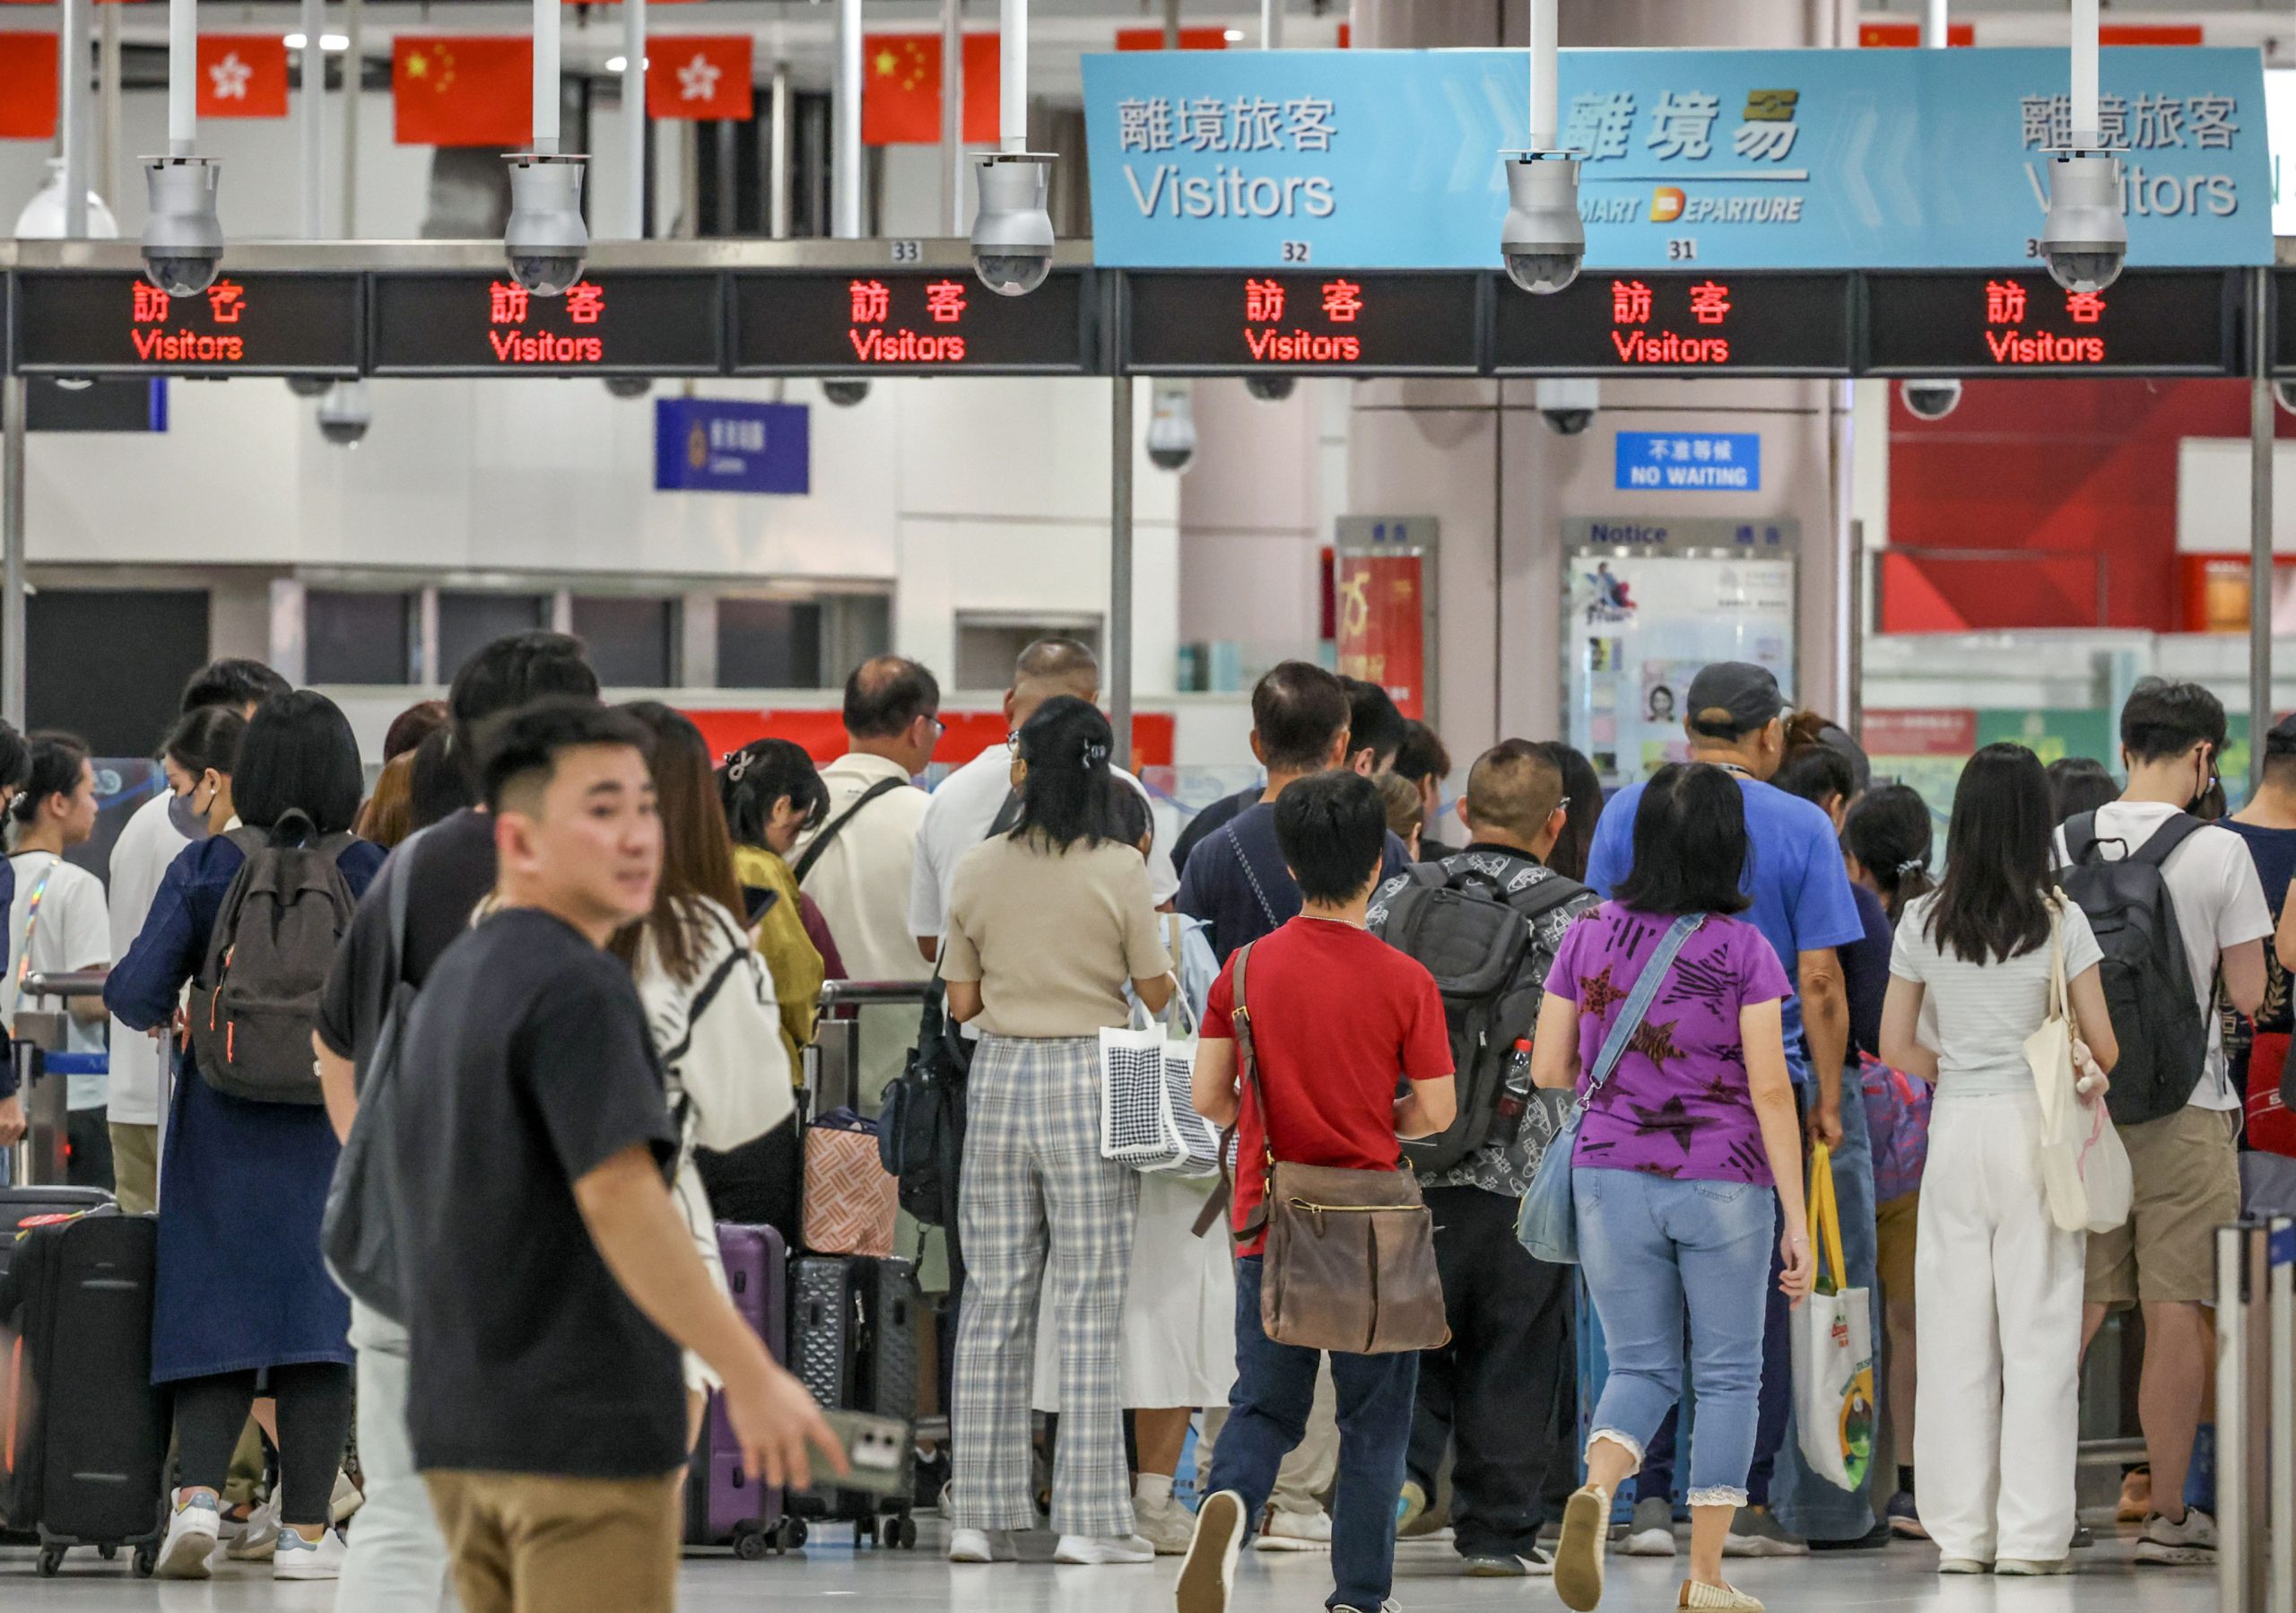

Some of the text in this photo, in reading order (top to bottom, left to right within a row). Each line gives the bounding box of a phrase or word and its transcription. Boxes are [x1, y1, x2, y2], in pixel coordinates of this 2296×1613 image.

[1118, 95, 1337, 153] 離境旅客
[1123, 164, 1336, 218] Visitors
[1578, 186, 1805, 223] MART DEPARTURE
[2024, 162, 2239, 216] Vitors
[892, 242, 919, 260] 33
[1283, 242, 1307, 262] 32
[1668, 240, 1694, 259] 31
[132, 329, 245, 361] Visitors
[489, 330, 604, 362] Visitors
[849, 328, 965, 362] Visitors
[1244, 328, 1361, 361] Visitors
[1612, 331, 1729, 363] Visitors
[1986, 330, 2104, 363] Visitors
[1631, 466, 1748, 487] NO WAITING
[1590, 523, 1668, 544] Notice
